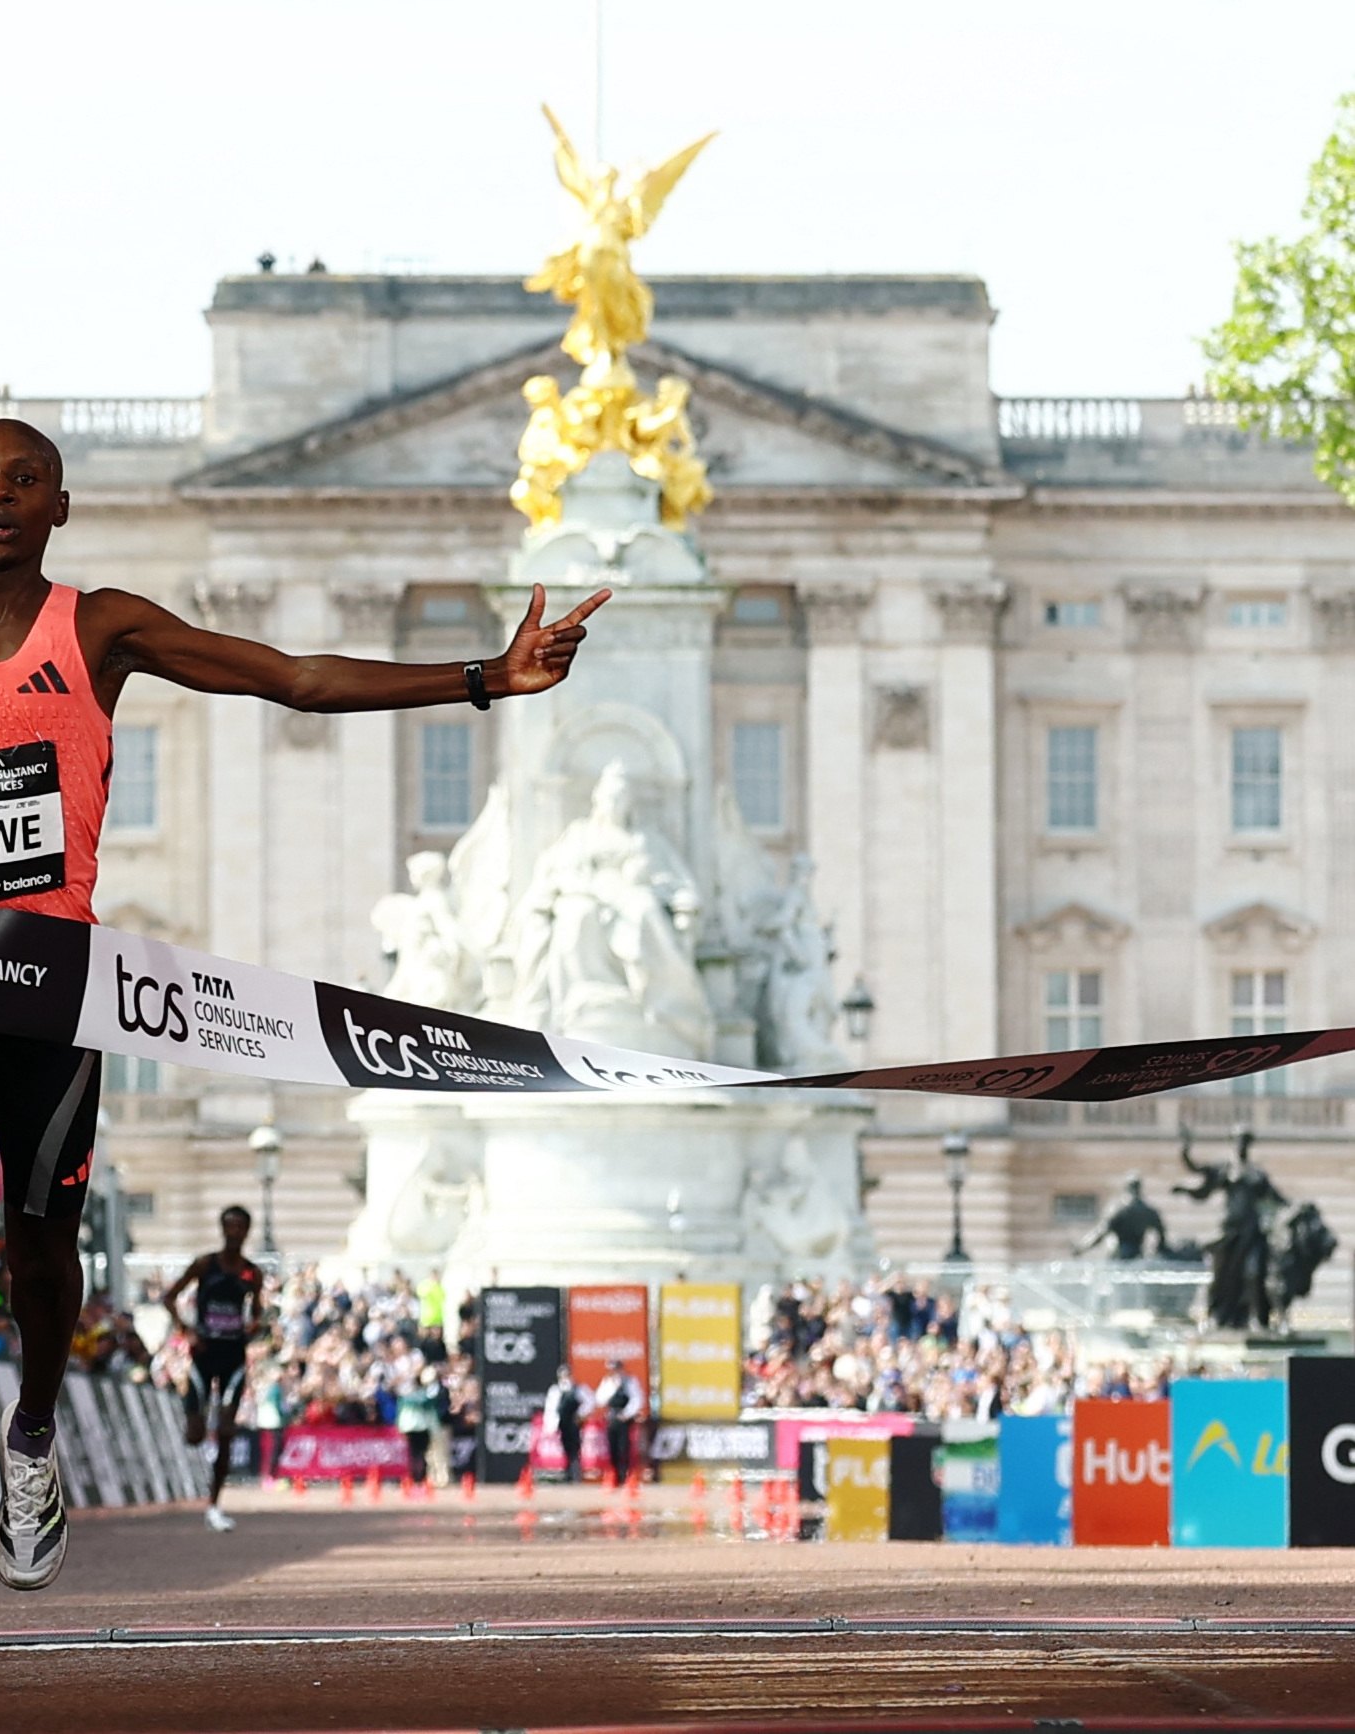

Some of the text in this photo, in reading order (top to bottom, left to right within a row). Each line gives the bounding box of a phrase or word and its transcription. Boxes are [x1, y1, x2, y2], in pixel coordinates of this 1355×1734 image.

[3, 874, 51, 892] balance
[116, 953, 189, 1043] tcs
[191, 972, 235, 1001] TATA
[194, 1000, 293, 1041] CONSULTANCY
[197, 1028, 266, 1059] SERVICES
[343, 1007, 440, 1081] tcs
[421, 1023, 472, 1052] TATA
[432, 1049, 545, 1079] CONSULTANCY
[444, 1069, 526, 1088] SERVICES
